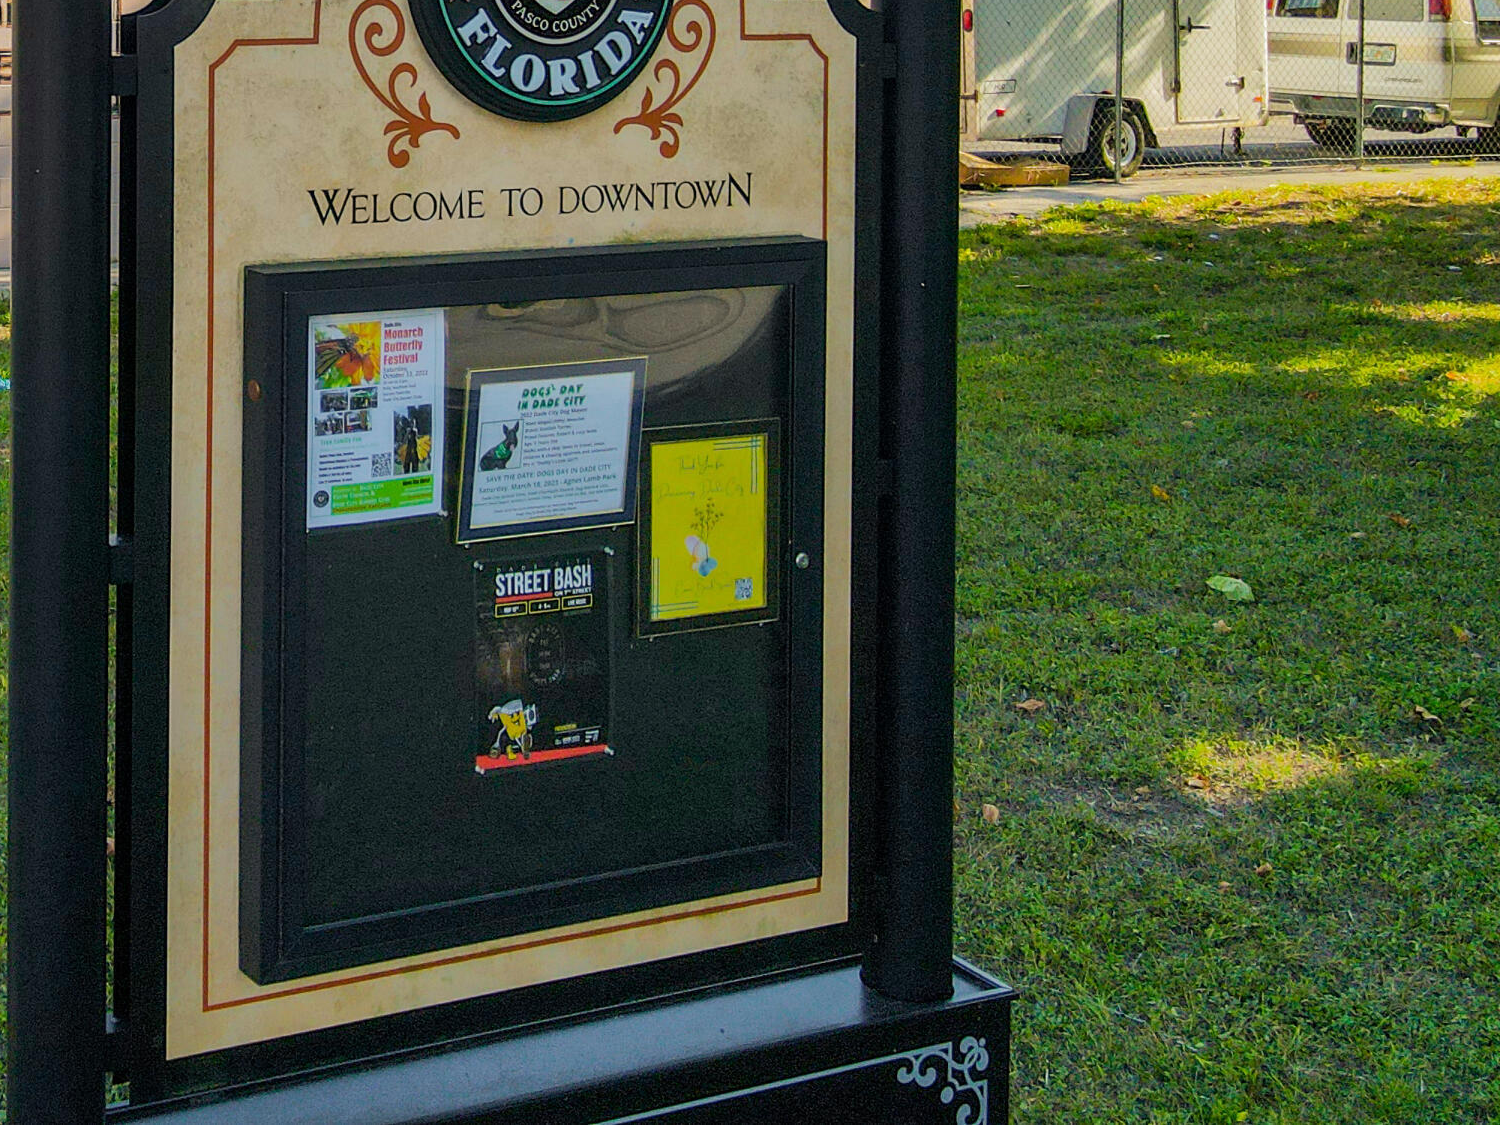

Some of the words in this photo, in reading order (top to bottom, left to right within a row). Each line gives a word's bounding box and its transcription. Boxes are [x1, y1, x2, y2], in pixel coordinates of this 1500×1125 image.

[511, 0, 549, 30] PASCO
[552, 0, 600, 32] COUNTY
[457, 8, 654, 96] FLORIDA
[500, 187, 543, 217] TO
[558, 172, 753, 215] DOWNTOWN
[384, 326, 423, 339] Monarch
[384, 339, 423, 352] Butterfly
[383, 352, 418, 365] Festival
[560, 383, 584, 395] DAY
[517, 399, 528, 410] IN
[532, 397, 560, 409] DADE
[563, 395, 586, 406] CITY
[495, 569, 551, 597] STREET
[554, 564, 592, 590] BASH
